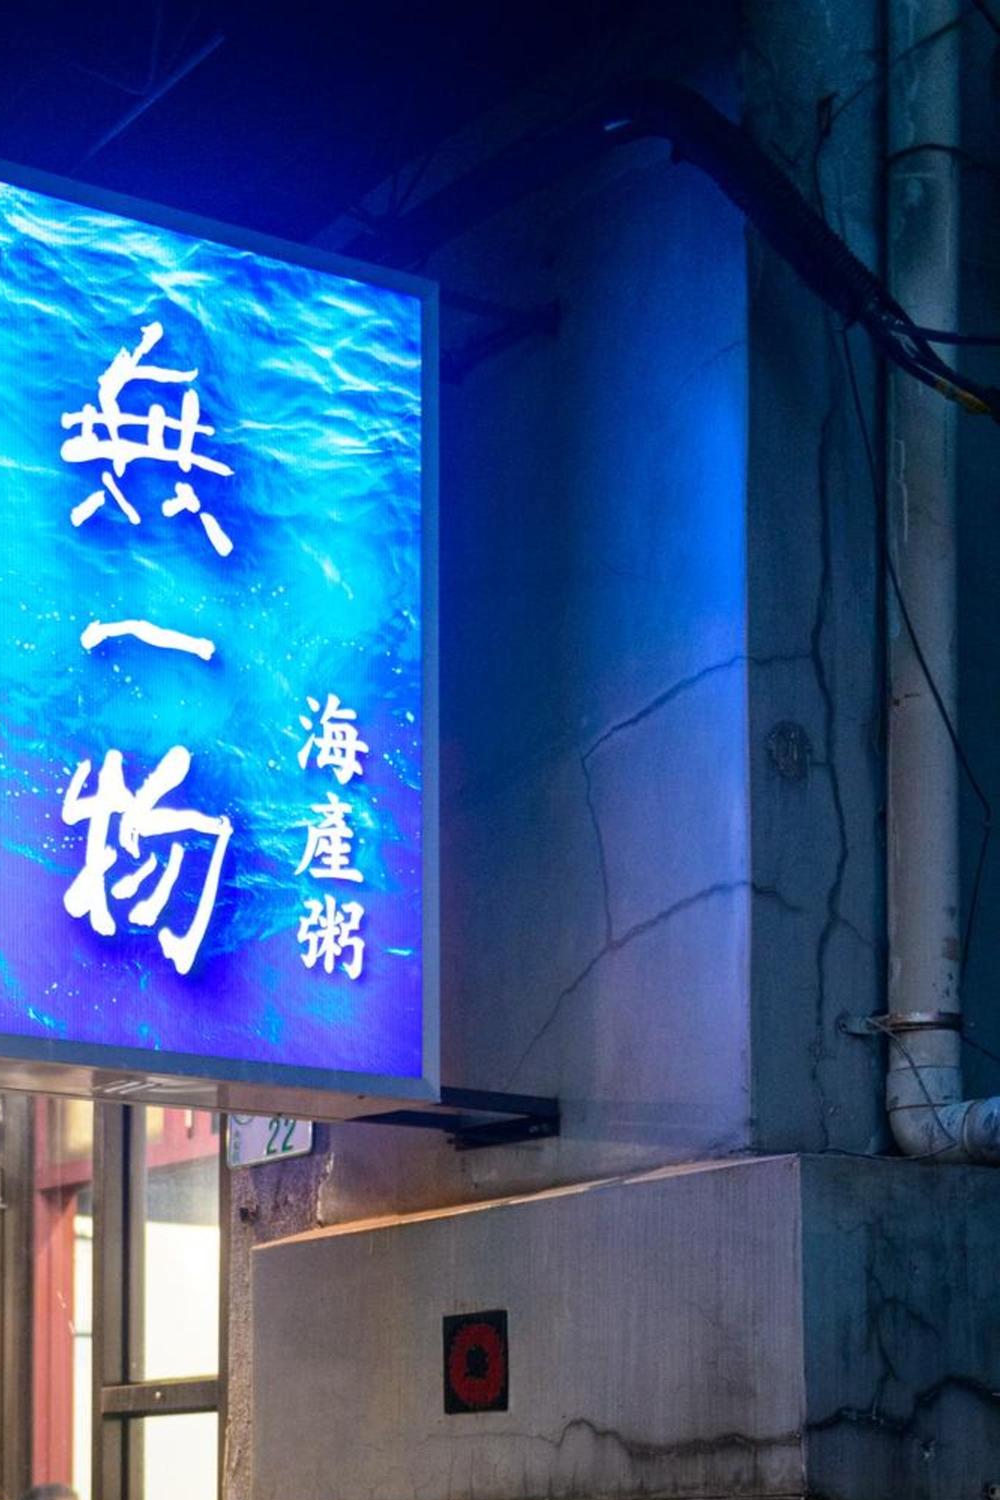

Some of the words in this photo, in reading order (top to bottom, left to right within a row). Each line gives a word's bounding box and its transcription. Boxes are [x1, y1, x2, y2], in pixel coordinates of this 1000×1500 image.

[59, 321, 233, 976] 無一物
[295, 692, 370, 980] 海產粥
[266, 1117, 296, 1156] 22
